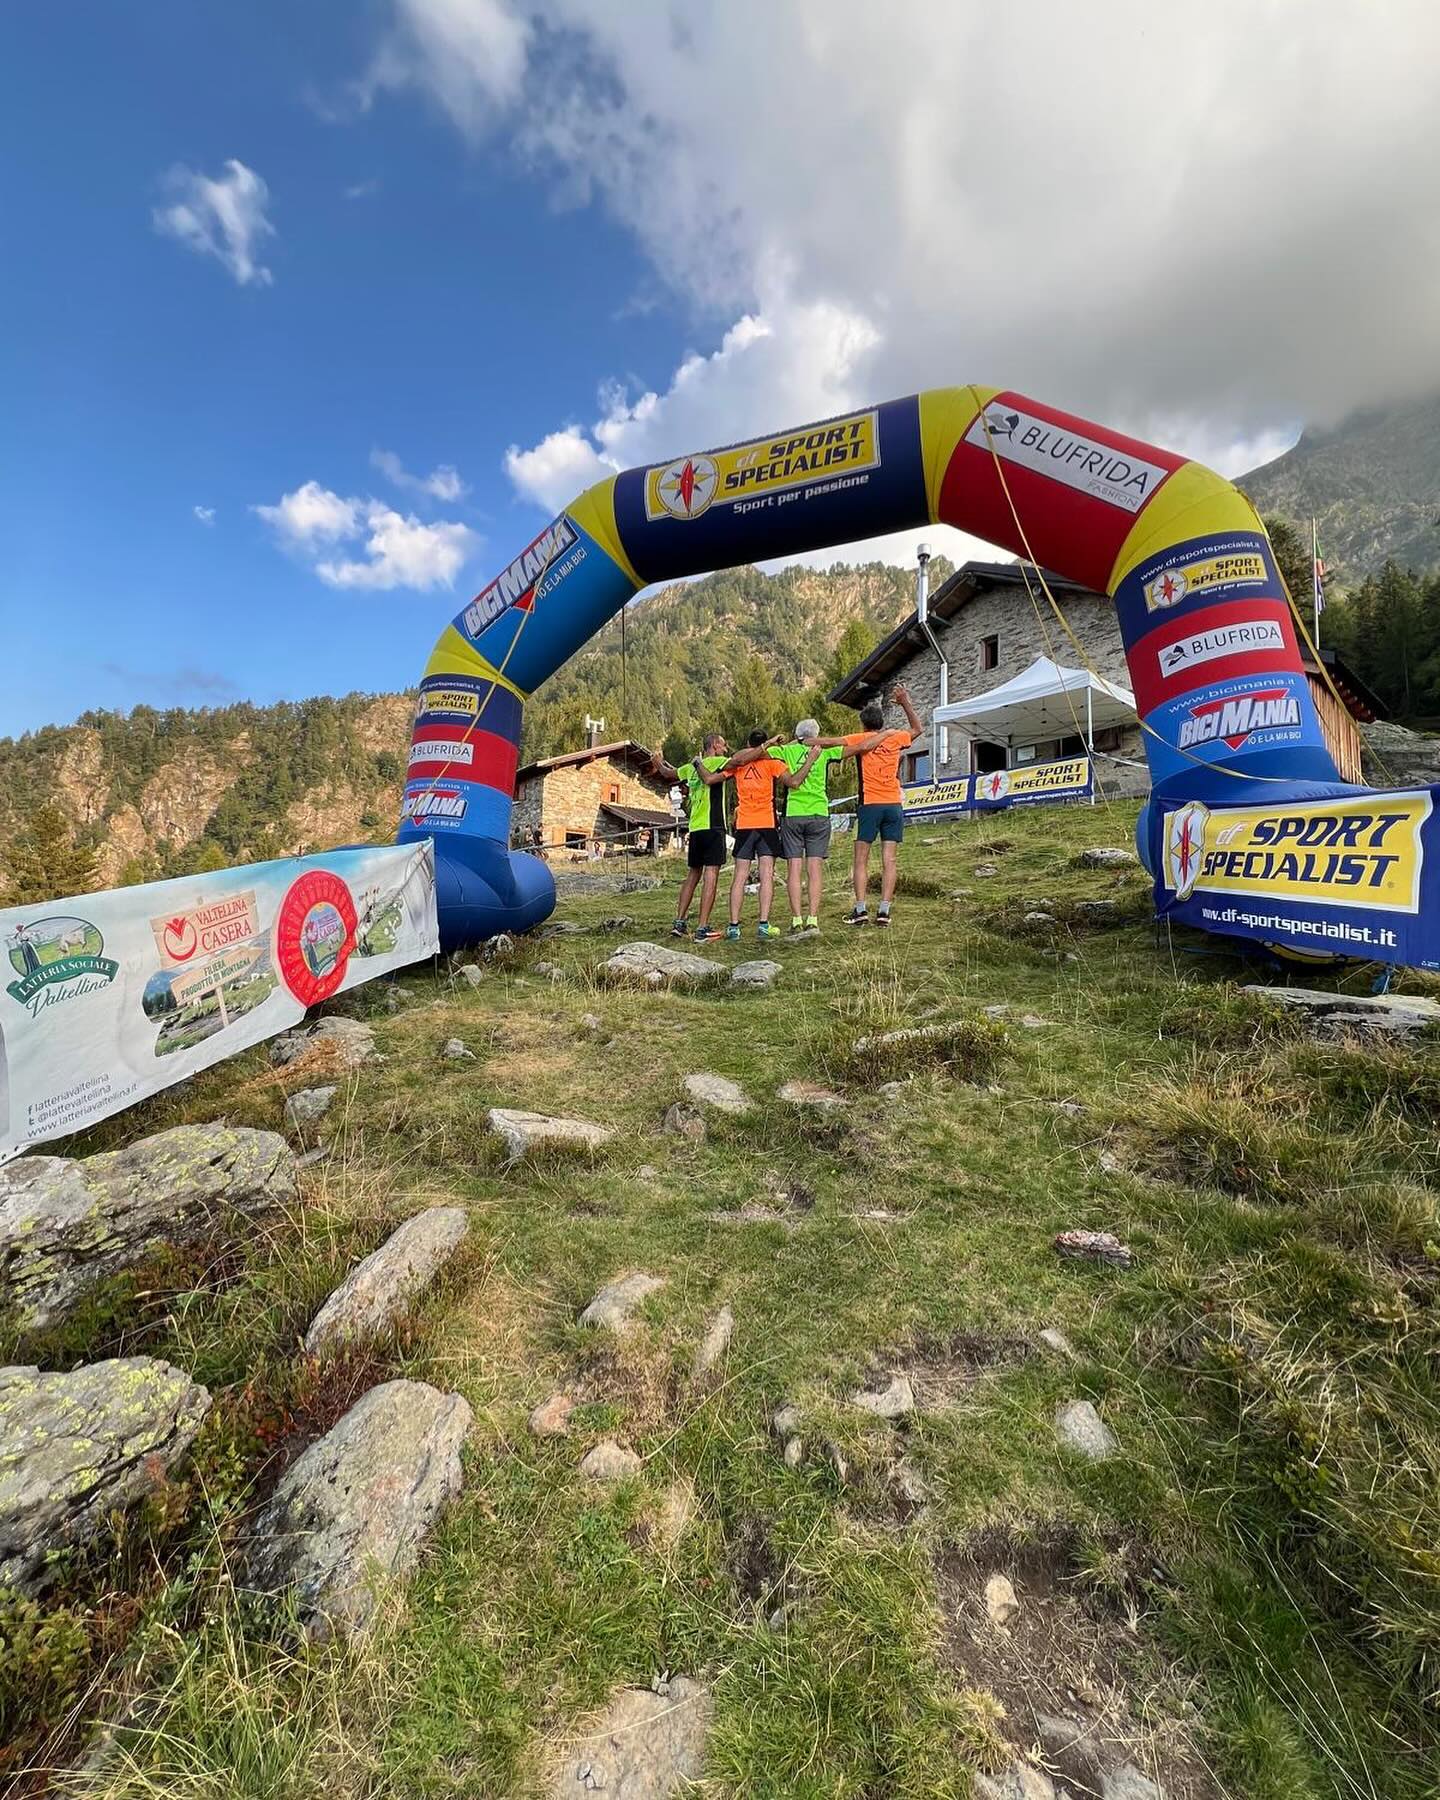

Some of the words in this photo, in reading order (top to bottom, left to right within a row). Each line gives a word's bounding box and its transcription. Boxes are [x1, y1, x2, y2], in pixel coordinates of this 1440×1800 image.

[769, 421, 865, 460] SPORT
[725, 440, 865, 490] SPECIALIST
[1020, 426, 1149, 494] BLUFRIDA
[733, 495, 775, 514] Sport
[777, 490, 802, 506] per
[805, 475, 870, 500] passione
[1087, 481, 1138, 507] FASHION
[550, 573, 562, 586] LA
[559, 561, 575, 577] MIA
[571, 547, 588, 566] BICI
[1140, 541, 1260, 581] www.df-sportspecialist.it
[1192, 568, 1260, 585] SPECIALIST
[1216, 557, 1259, 571] SPORT
[1191, 626, 1280, 655] BLUFRIDA
[442, 694, 473, 703] SPORT
[1168, 678, 1296, 714] www.bicimania.it
[1014, 774, 1083, 789] SPECIALIST
[1036, 763, 1084, 778] SPORT
[908, 791, 962, 805] SPECIALIST
[927, 784, 963, 796] SPORT
[1215, 821, 1243, 845] df
[1248, 815, 1412, 848] SPORT
[1201, 852, 1400, 887] SPECIALIST
[196, 900, 248, 925] VALTELLINA
[201, 919, 252, 951] CASERA
[19, 964, 68, 996] LATTERIA
[68, 960, 112, 972] SOCIALE
[25, 978, 109, 1019] Valtellina
[34, 1072, 110, 1112] latteriavaltellina
[37, 1084, 112, 1122] @lattevaltellina
[27, 1083, 138, 1138] www.latteriavaltellina.it
